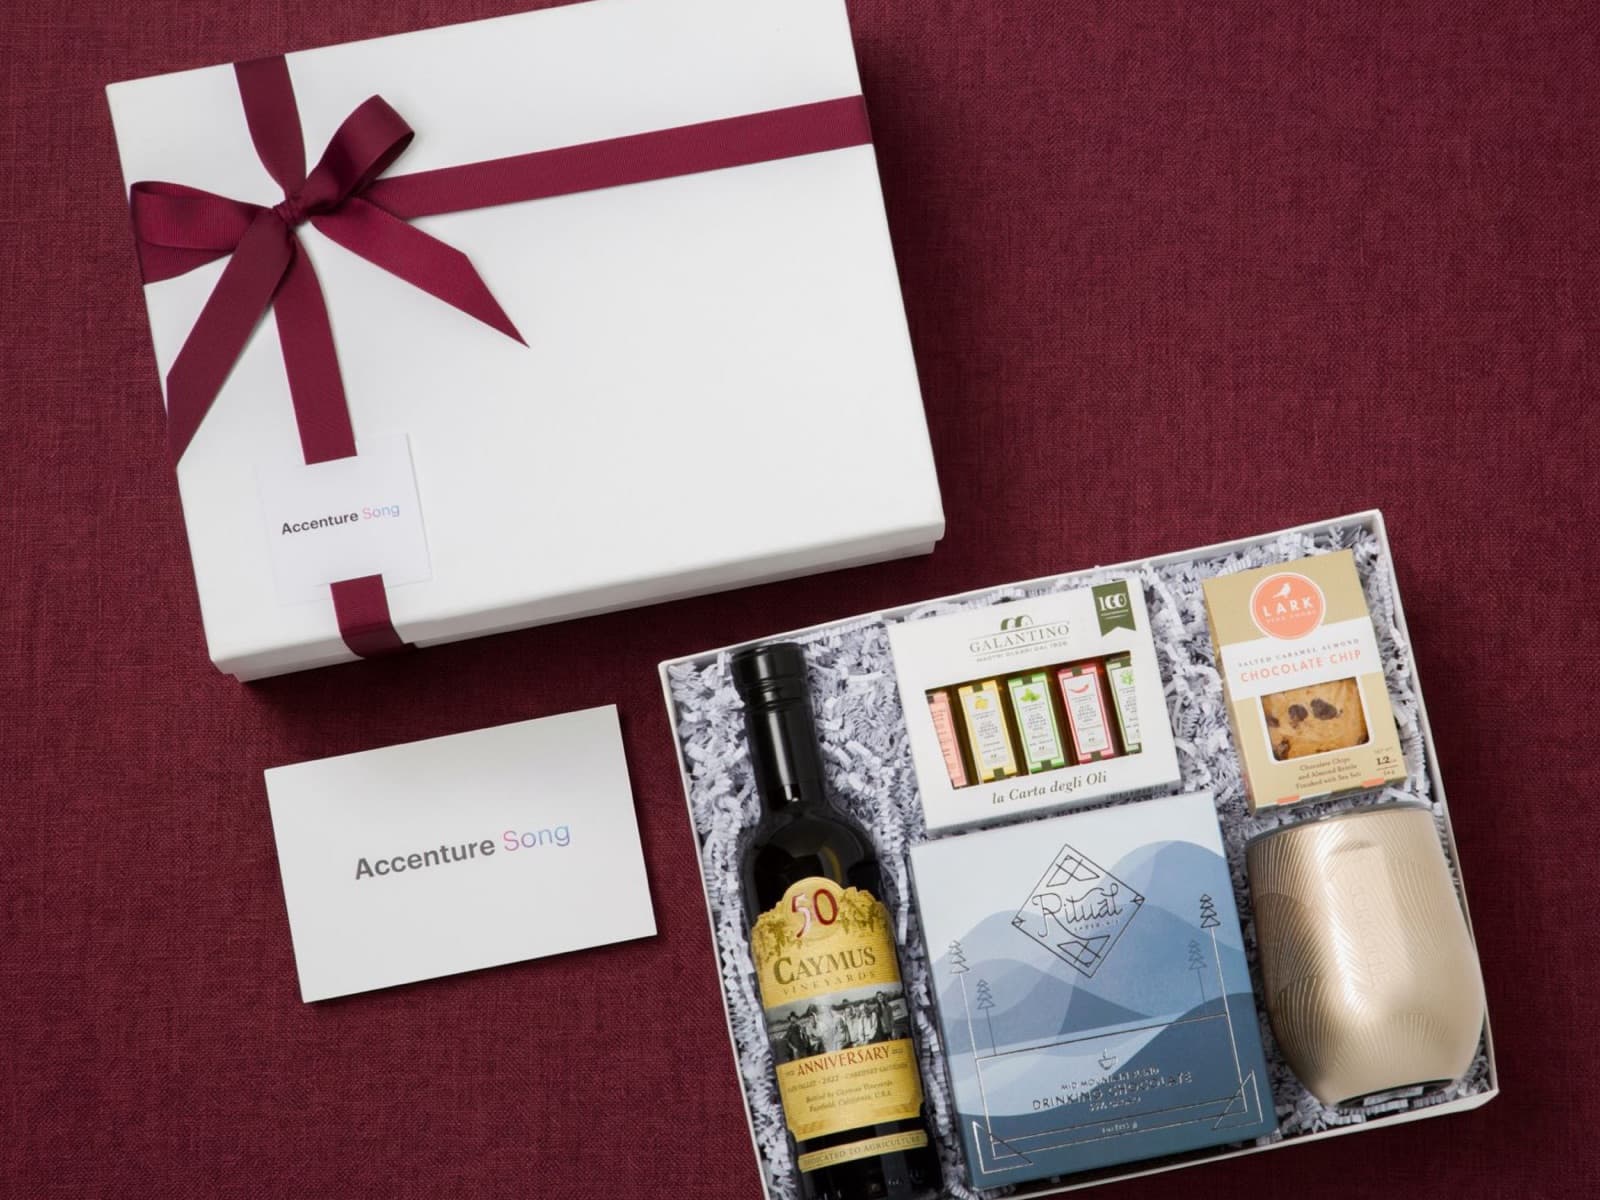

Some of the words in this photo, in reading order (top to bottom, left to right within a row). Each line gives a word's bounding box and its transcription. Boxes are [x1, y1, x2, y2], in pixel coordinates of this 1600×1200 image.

[281, 511, 359, 536] Accenture
[362, 502, 401, 521] Song
[1262, 596, 1313, 617] LARK
[969, 624, 1069, 653] GALANTINO
[1238, 656, 1272, 668] SALTED
[1275, 647, 1317, 660] CARAMEL
[1321, 638, 1359, 651] ALMOND
[1240, 656, 1323, 682] CHOCOLATE
[1329, 649, 1360, 664] CHIP
[992, 791, 1005, 804] la
[1009, 786, 1046, 801] Carta
[1050, 775, 1082, 793] degli
[1086, 770, 1107, 785] Oli
[355, 836, 496, 880] Accenture
[503, 824, 571, 853] Song
[791, 888, 838, 938] 50
[1031, 882, 1123, 938] Ritual
[773, 946, 876, 985] CAYMUS
[783, 971, 875, 994] VINEYARDS
[797, 1045, 890, 1076] ANNIVERSARY
[1032, 1089, 1103, 1111] DRINKING
[1108, 1071, 1193, 1097] CHOCOLATE
[849, 1145, 861, 1156] TO
